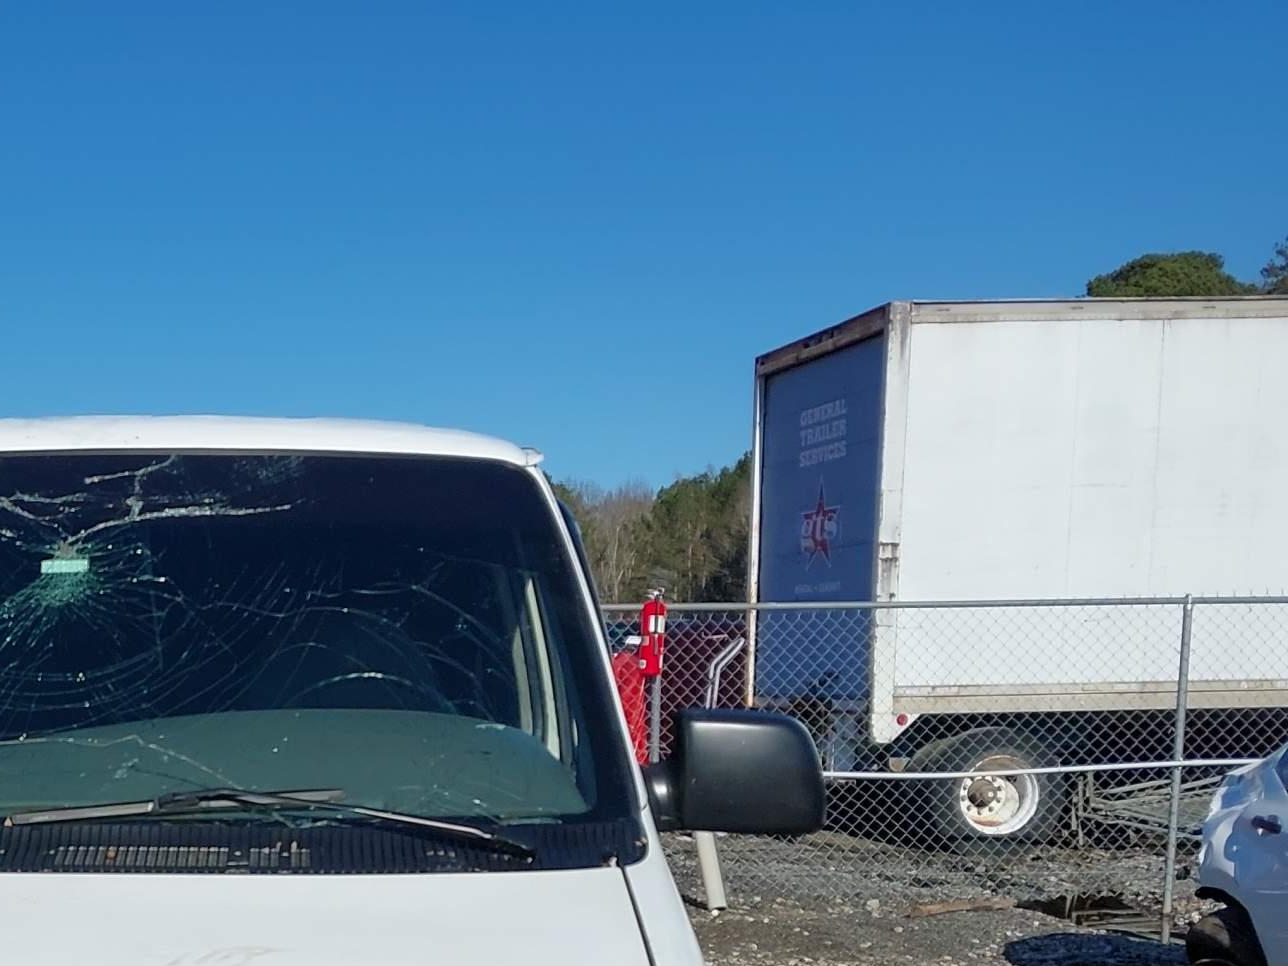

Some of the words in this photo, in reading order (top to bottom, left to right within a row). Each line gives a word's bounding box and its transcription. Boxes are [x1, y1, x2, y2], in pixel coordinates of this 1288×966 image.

[799, 398, 847, 426] GENERAL
[799, 418, 846, 447] TRAILER
[799, 440, 846, 467] SERVICES
